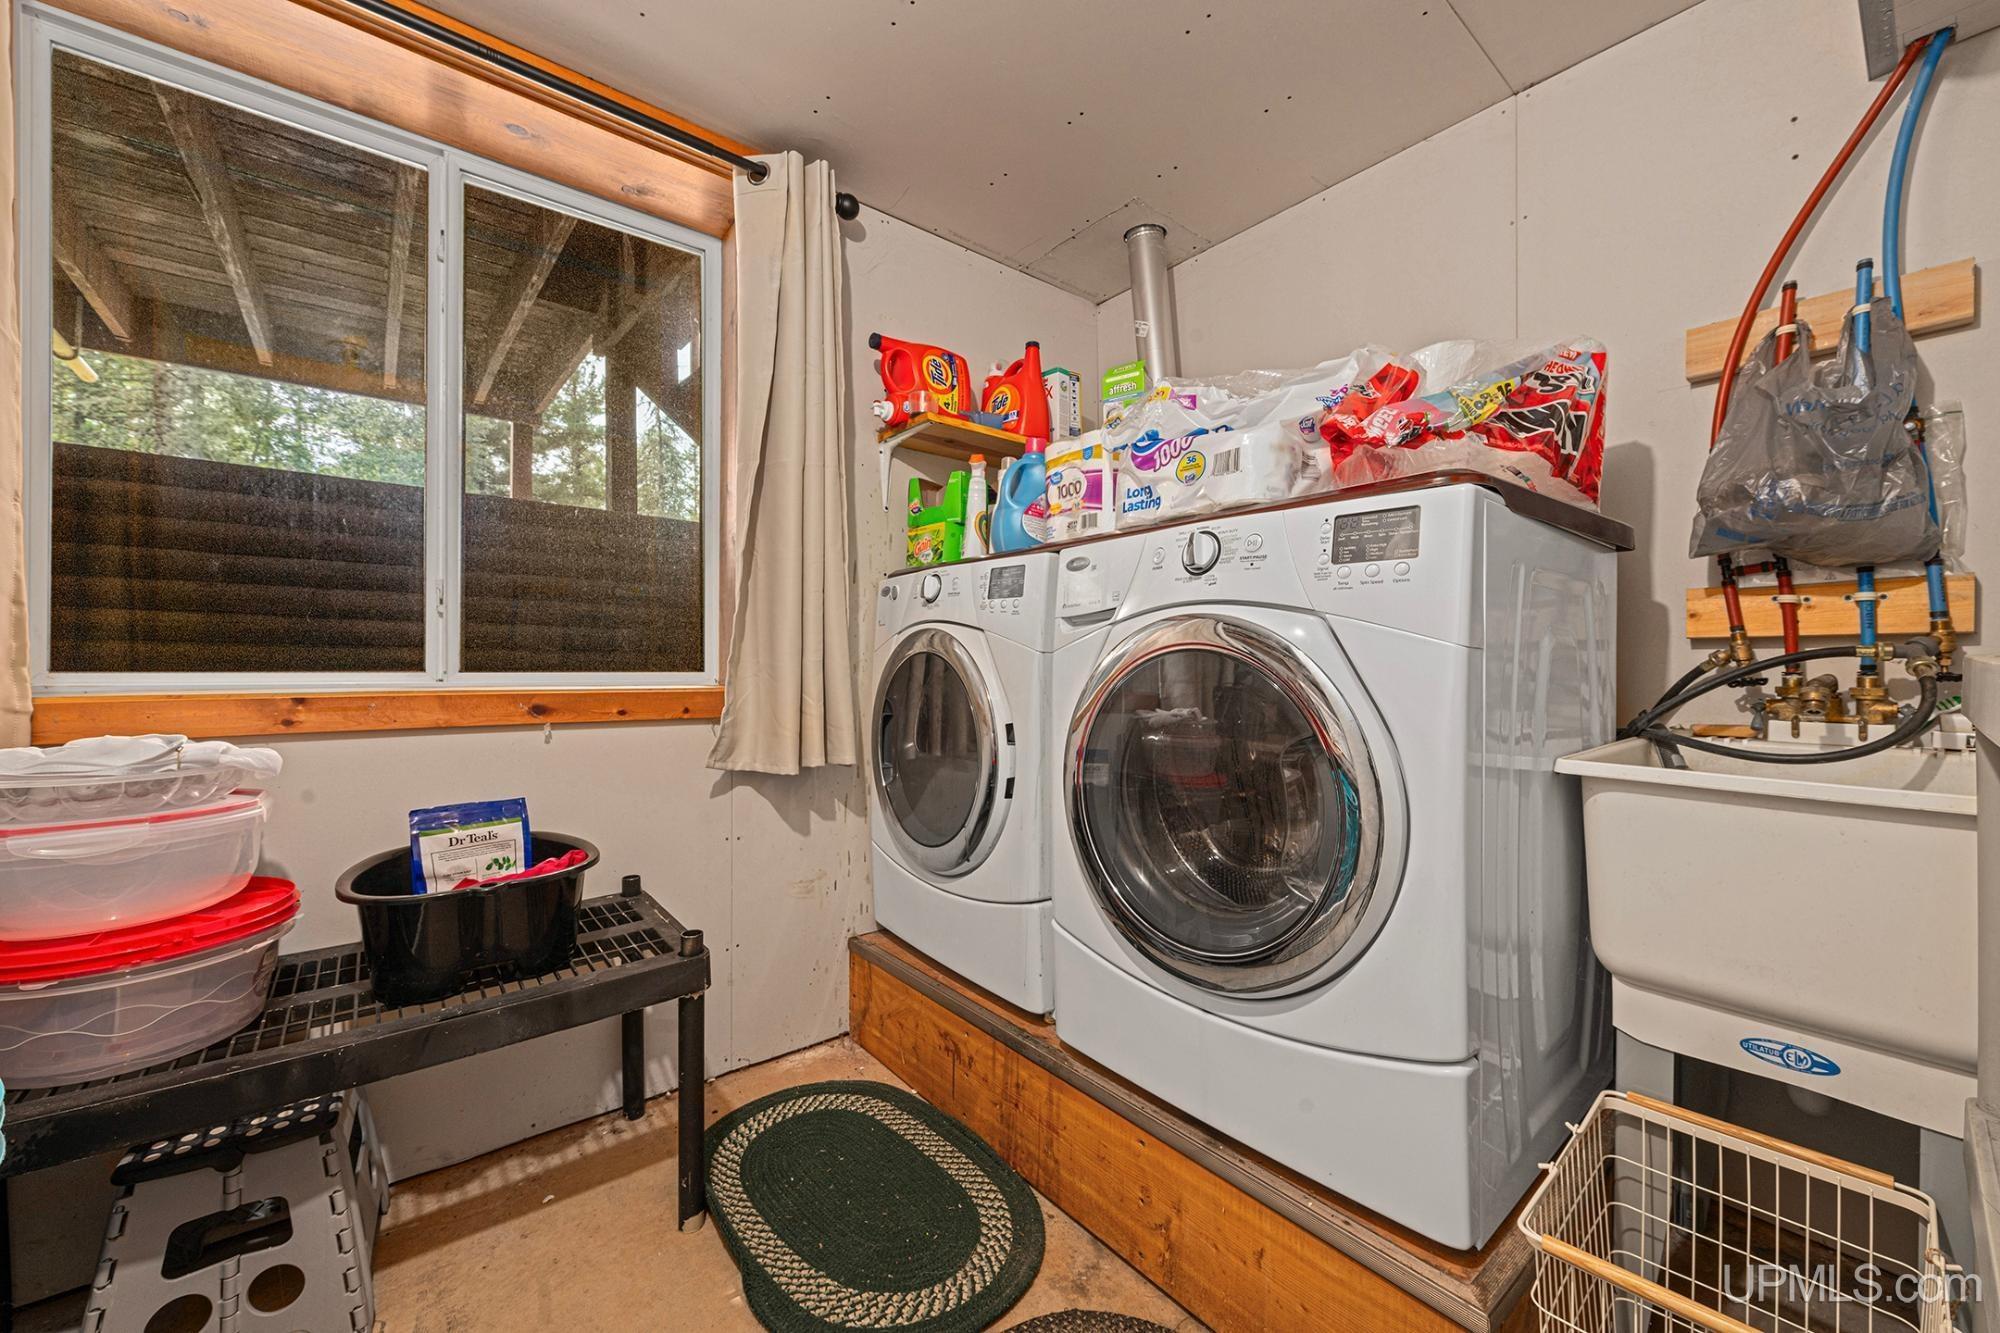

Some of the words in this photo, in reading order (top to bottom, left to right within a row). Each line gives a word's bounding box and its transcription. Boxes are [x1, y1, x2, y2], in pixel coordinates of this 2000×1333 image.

[929, 358, 948, 388] Tide
[1109, 381, 1137, 395] affresh
[991, 392, 1009, 413] Tide
[1153, 435, 1197, 473] 1000
[1186, 455, 1197, 465] 36
[1057, 480, 1083, 499] 1000
[1126, 485, 1153, 499] Long
[1122, 496, 1161, 513] Lasting
[914, 536, 933, 558] Gain
[448, 836, 466, 847] Dr
[466, 830, 499, 844] Teal's
[1742, 1041, 1781, 1057] UTILATUB
[1785, 1050, 1809, 1068] ELM
